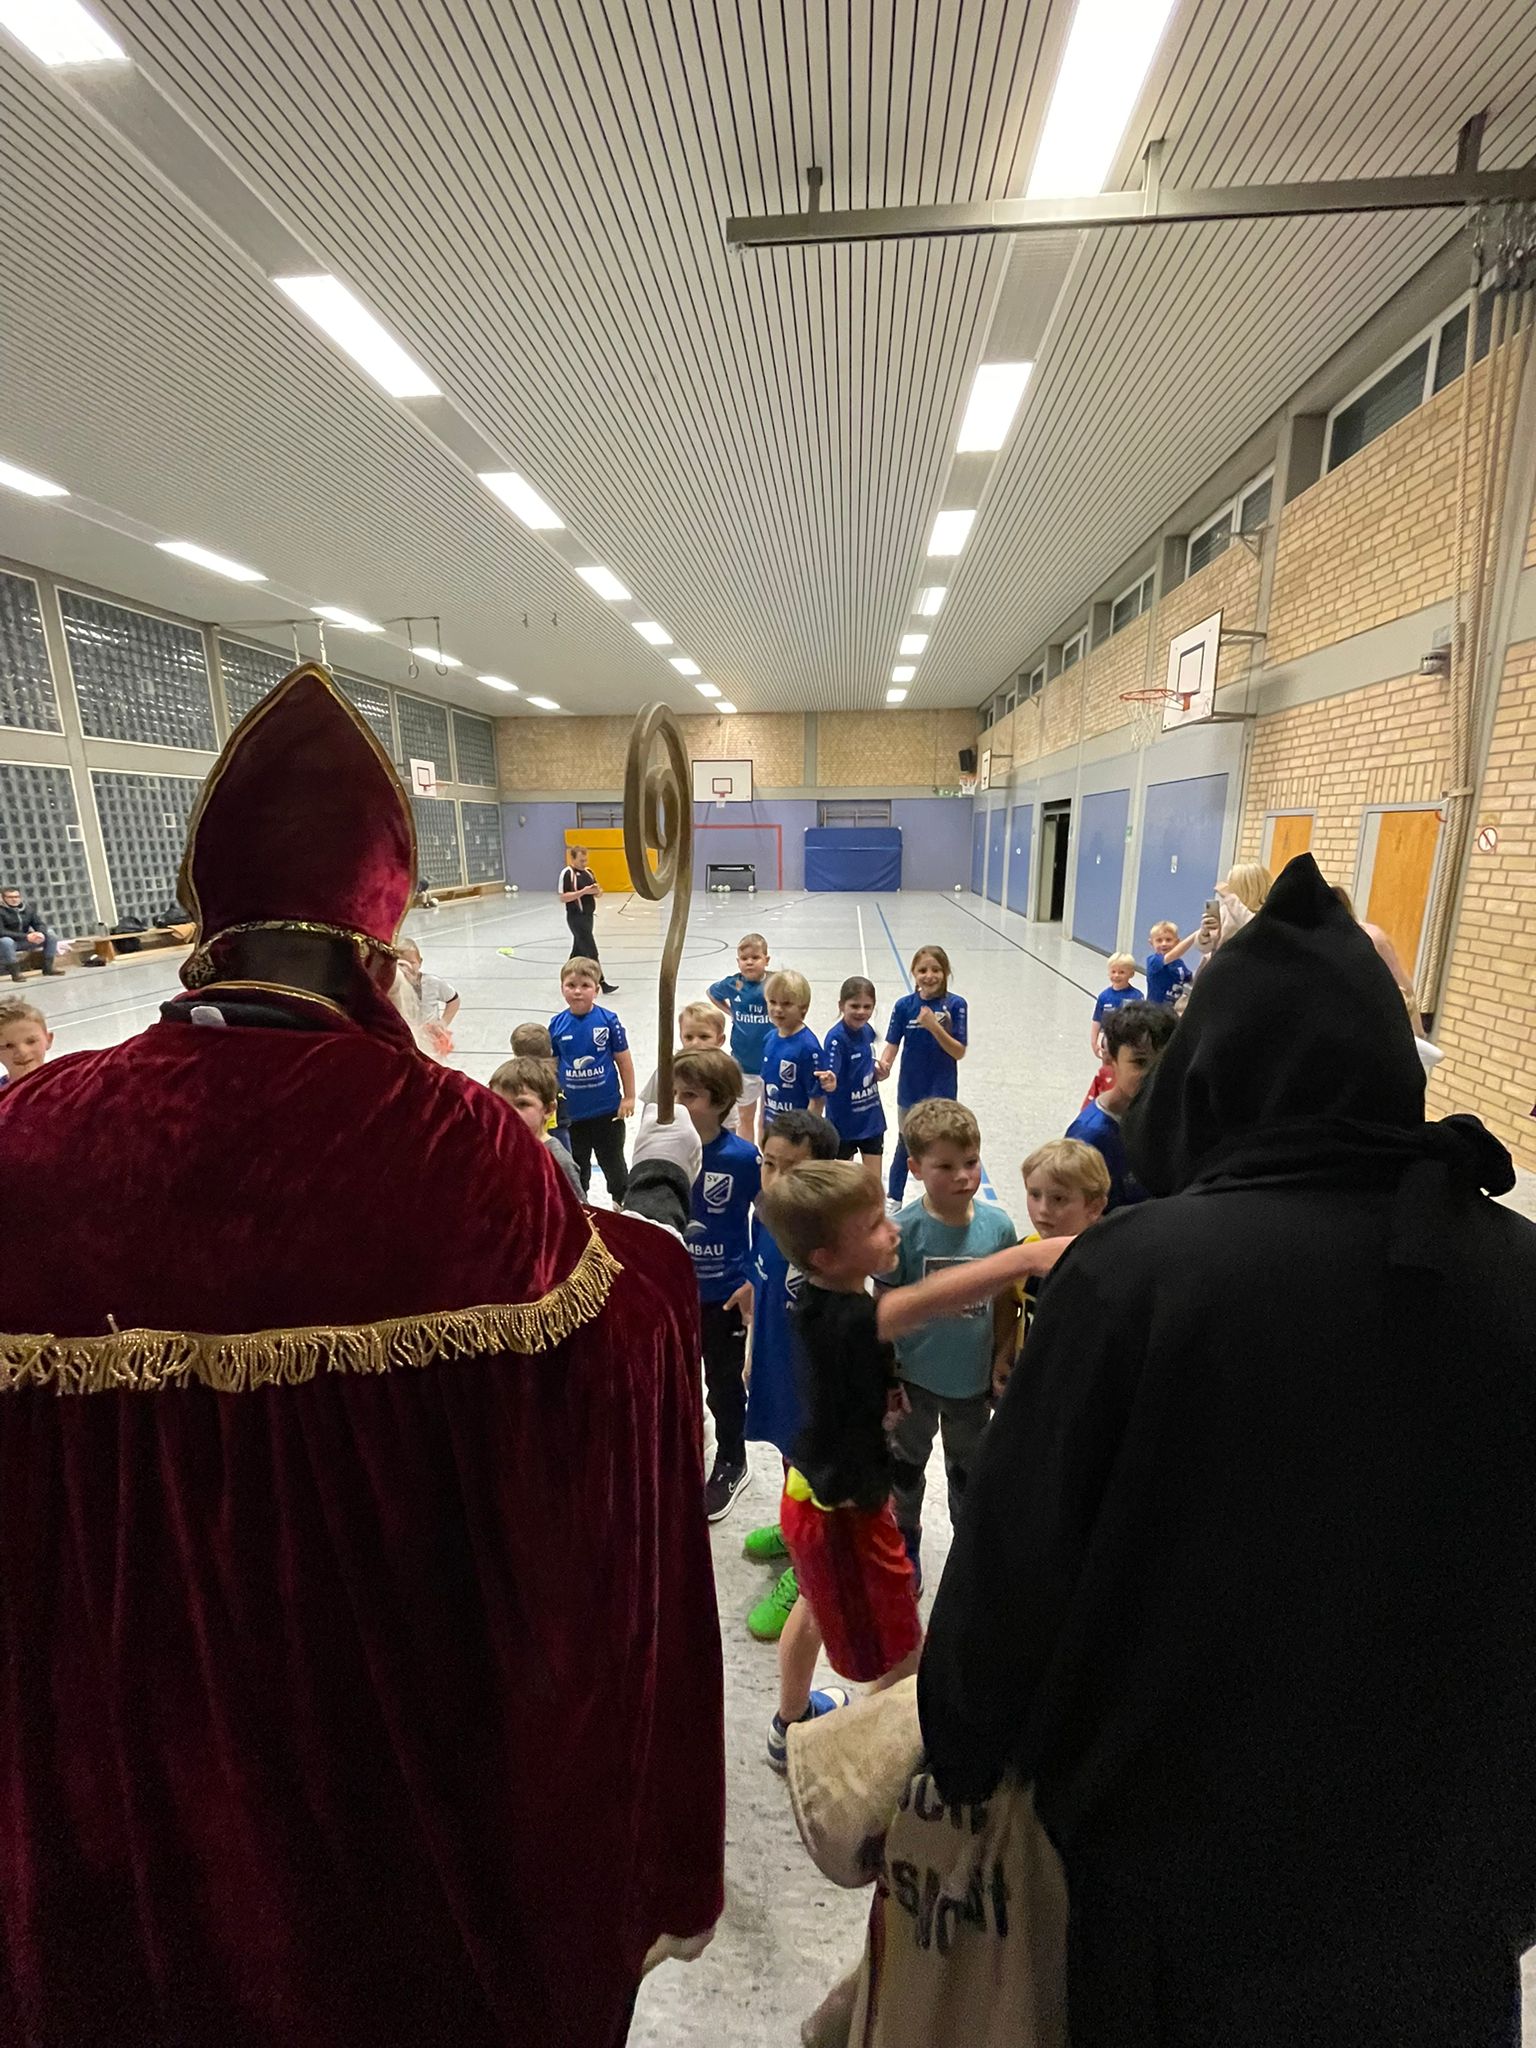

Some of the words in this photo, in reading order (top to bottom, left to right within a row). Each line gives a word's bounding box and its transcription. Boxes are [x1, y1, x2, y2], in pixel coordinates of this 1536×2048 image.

[565, 1065, 605, 1078] MAMBAU
[707, 1174, 719, 1183] SV
[688, 1243, 724, 1256] MBAU
